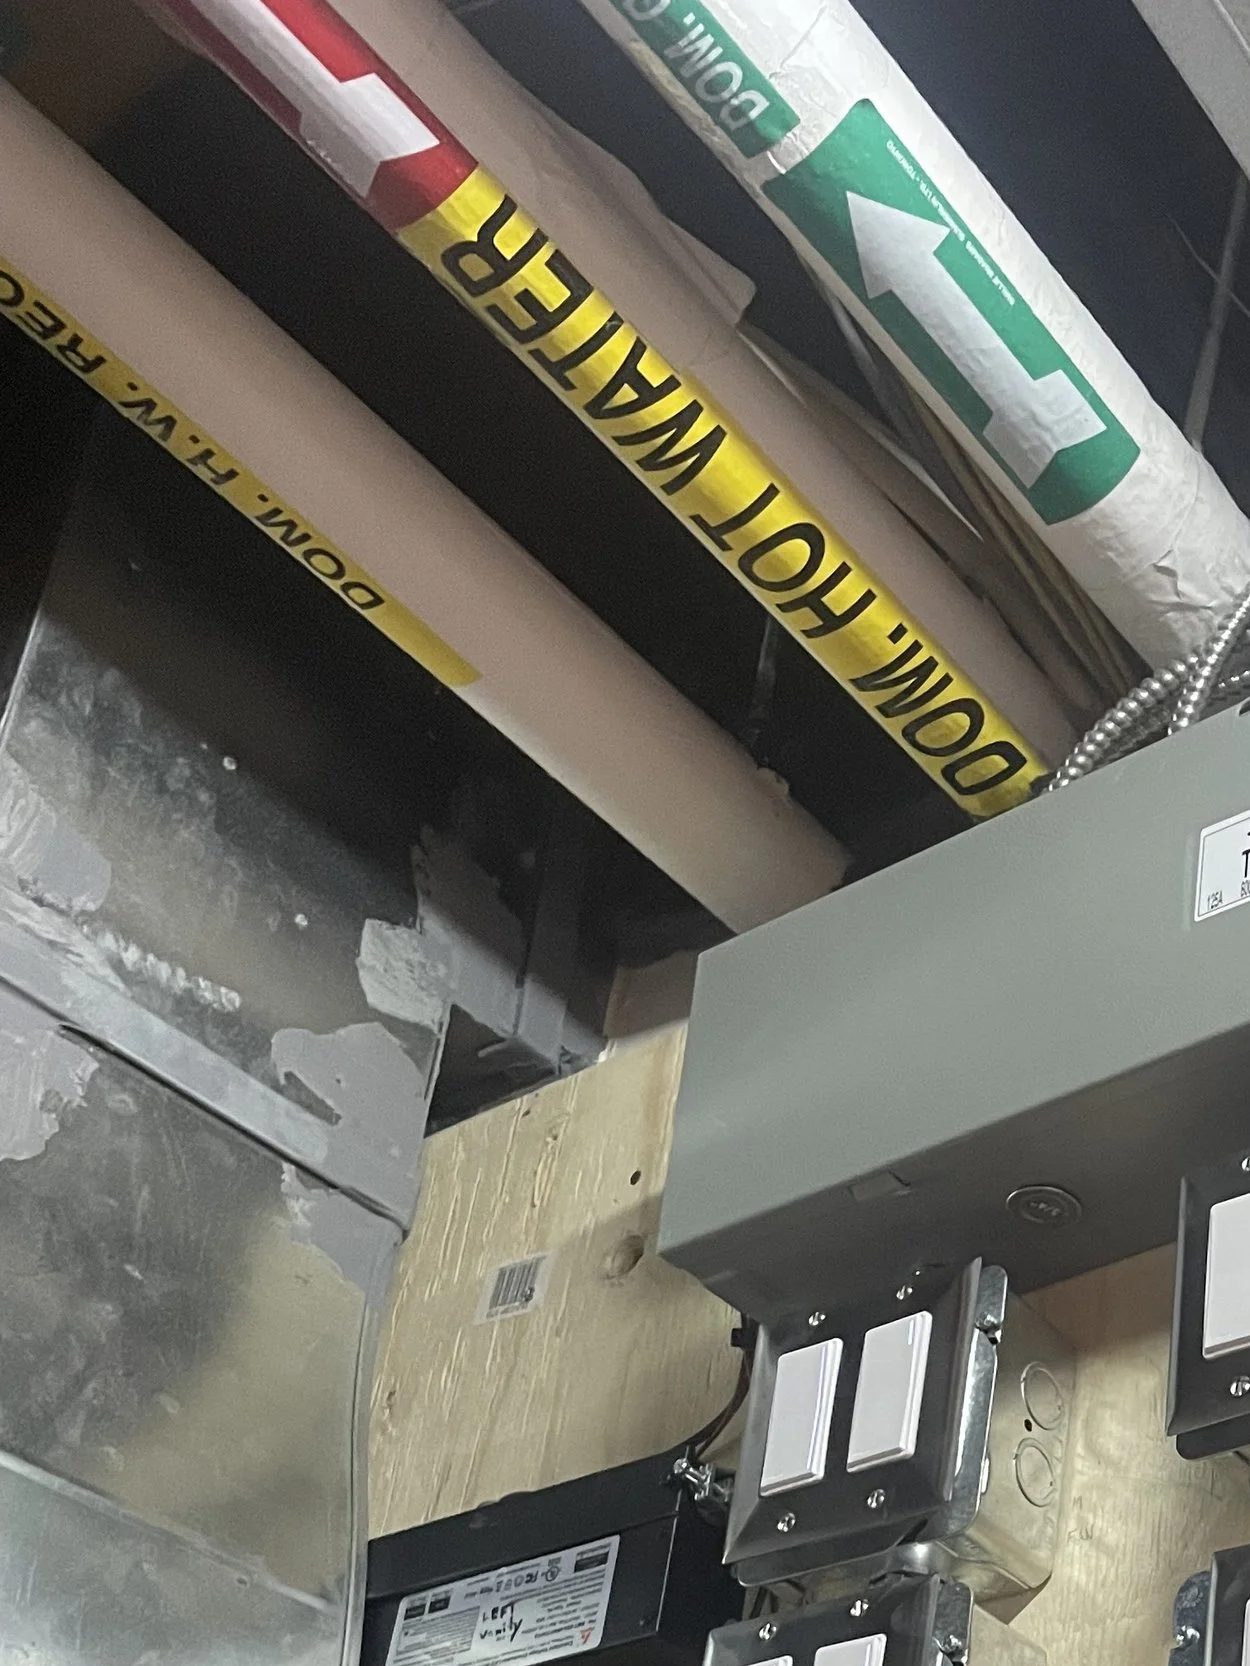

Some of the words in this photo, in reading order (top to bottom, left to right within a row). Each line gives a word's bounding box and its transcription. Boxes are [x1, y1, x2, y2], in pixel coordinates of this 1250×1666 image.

[664, 12, 771, 131] DOM.
[440, 194, 729, 497] WATER
[117, 381, 240, 487] H.W.
[255, 493, 386, 612] DOM.
[692, 482, 876, 639] HOT
[849, 622, 1028, 797] DOM.
